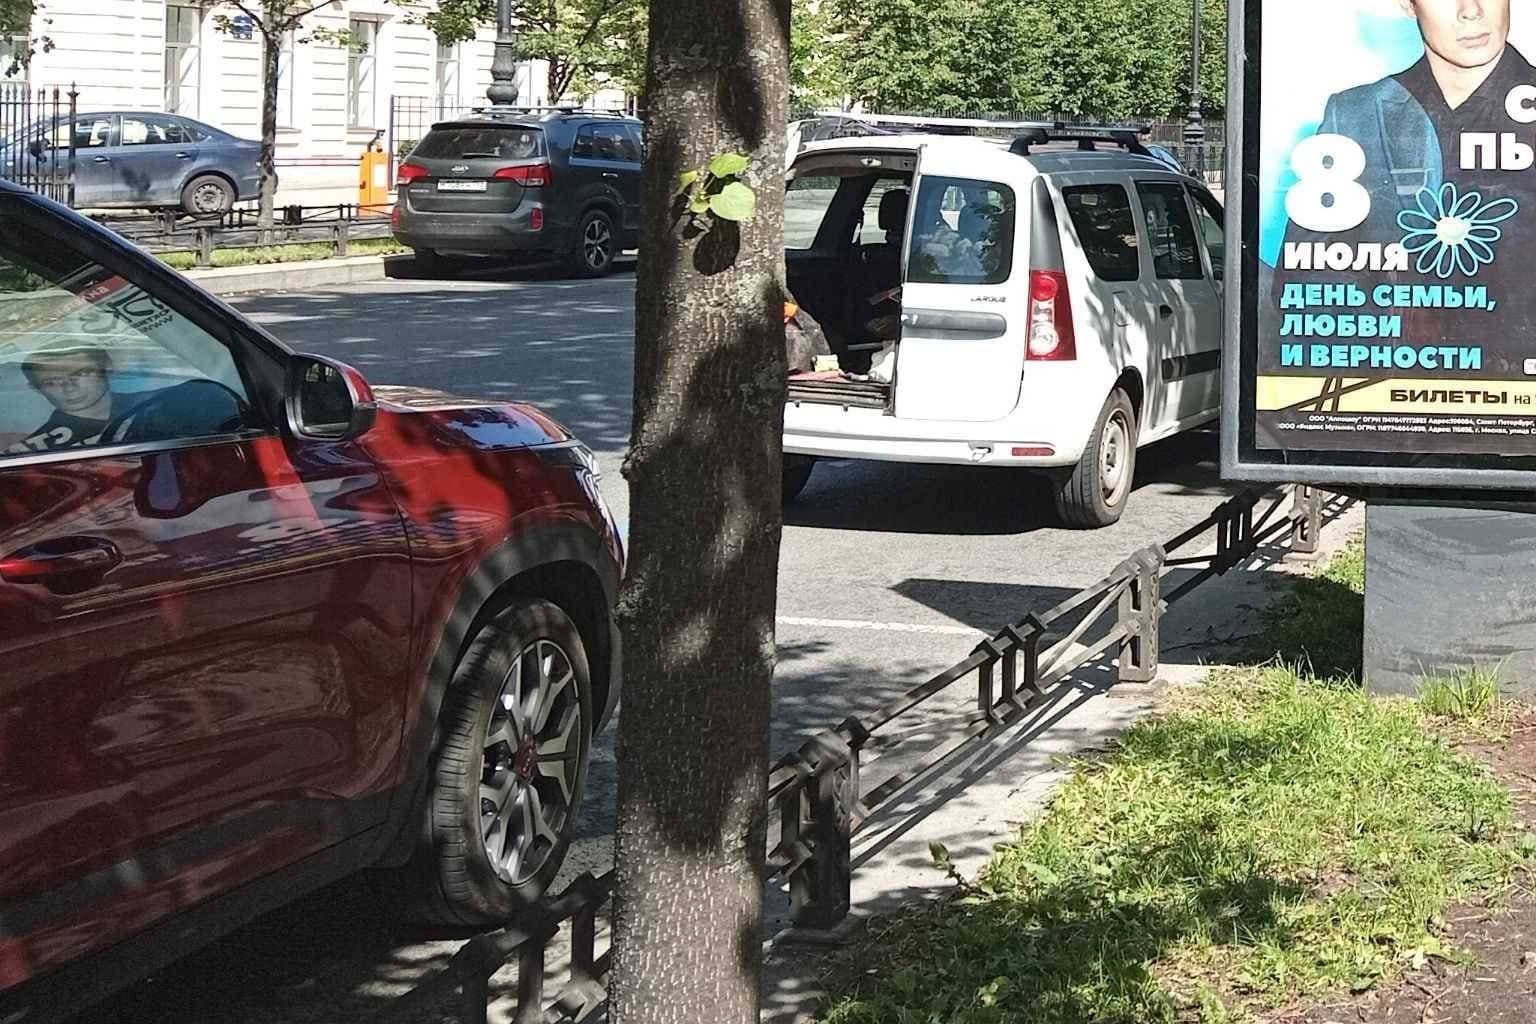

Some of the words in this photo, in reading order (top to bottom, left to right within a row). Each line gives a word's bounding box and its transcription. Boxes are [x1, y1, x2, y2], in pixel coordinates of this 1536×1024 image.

[1284, 133, 1371, 233] 8
[1283, 241, 1409, 271] ИЮЛЯ
[1280, 283, 1367, 309] ДЕНЬ
[1372, 284, 1497, 311] СЕМЬИ,
[1279, 313, 1401, 338] ЛЮБВИ
[1281, 344, 1303, 367] И
[1310, 344, 1482, 369] ВЕРНОСТИ
[1390, 389, 1508, 404] БИЛЕТЫ
[1514, 394, 1531, 405] на
